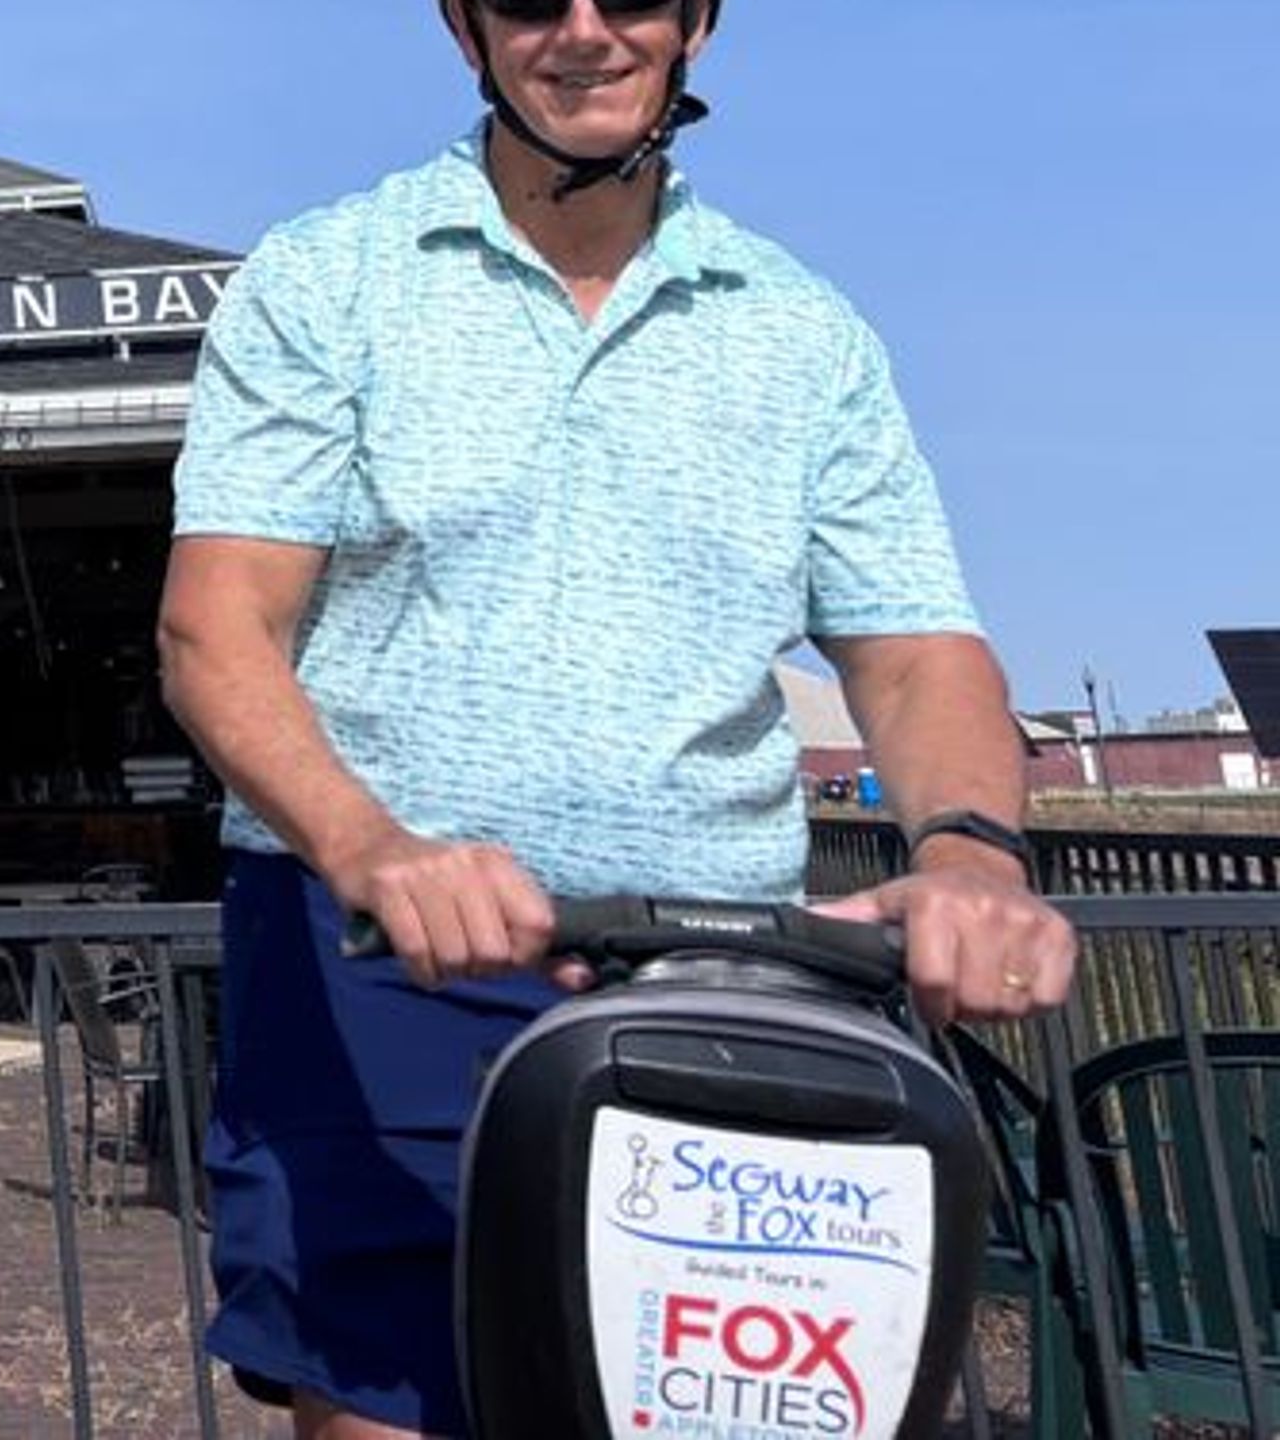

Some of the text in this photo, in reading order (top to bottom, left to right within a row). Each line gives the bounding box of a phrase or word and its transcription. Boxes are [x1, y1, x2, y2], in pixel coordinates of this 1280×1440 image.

[827, 1219, 903, 1249] tours
[662, 1293, 865, 1405] FOX
[659, 1366, 849, 1435] CITIES
